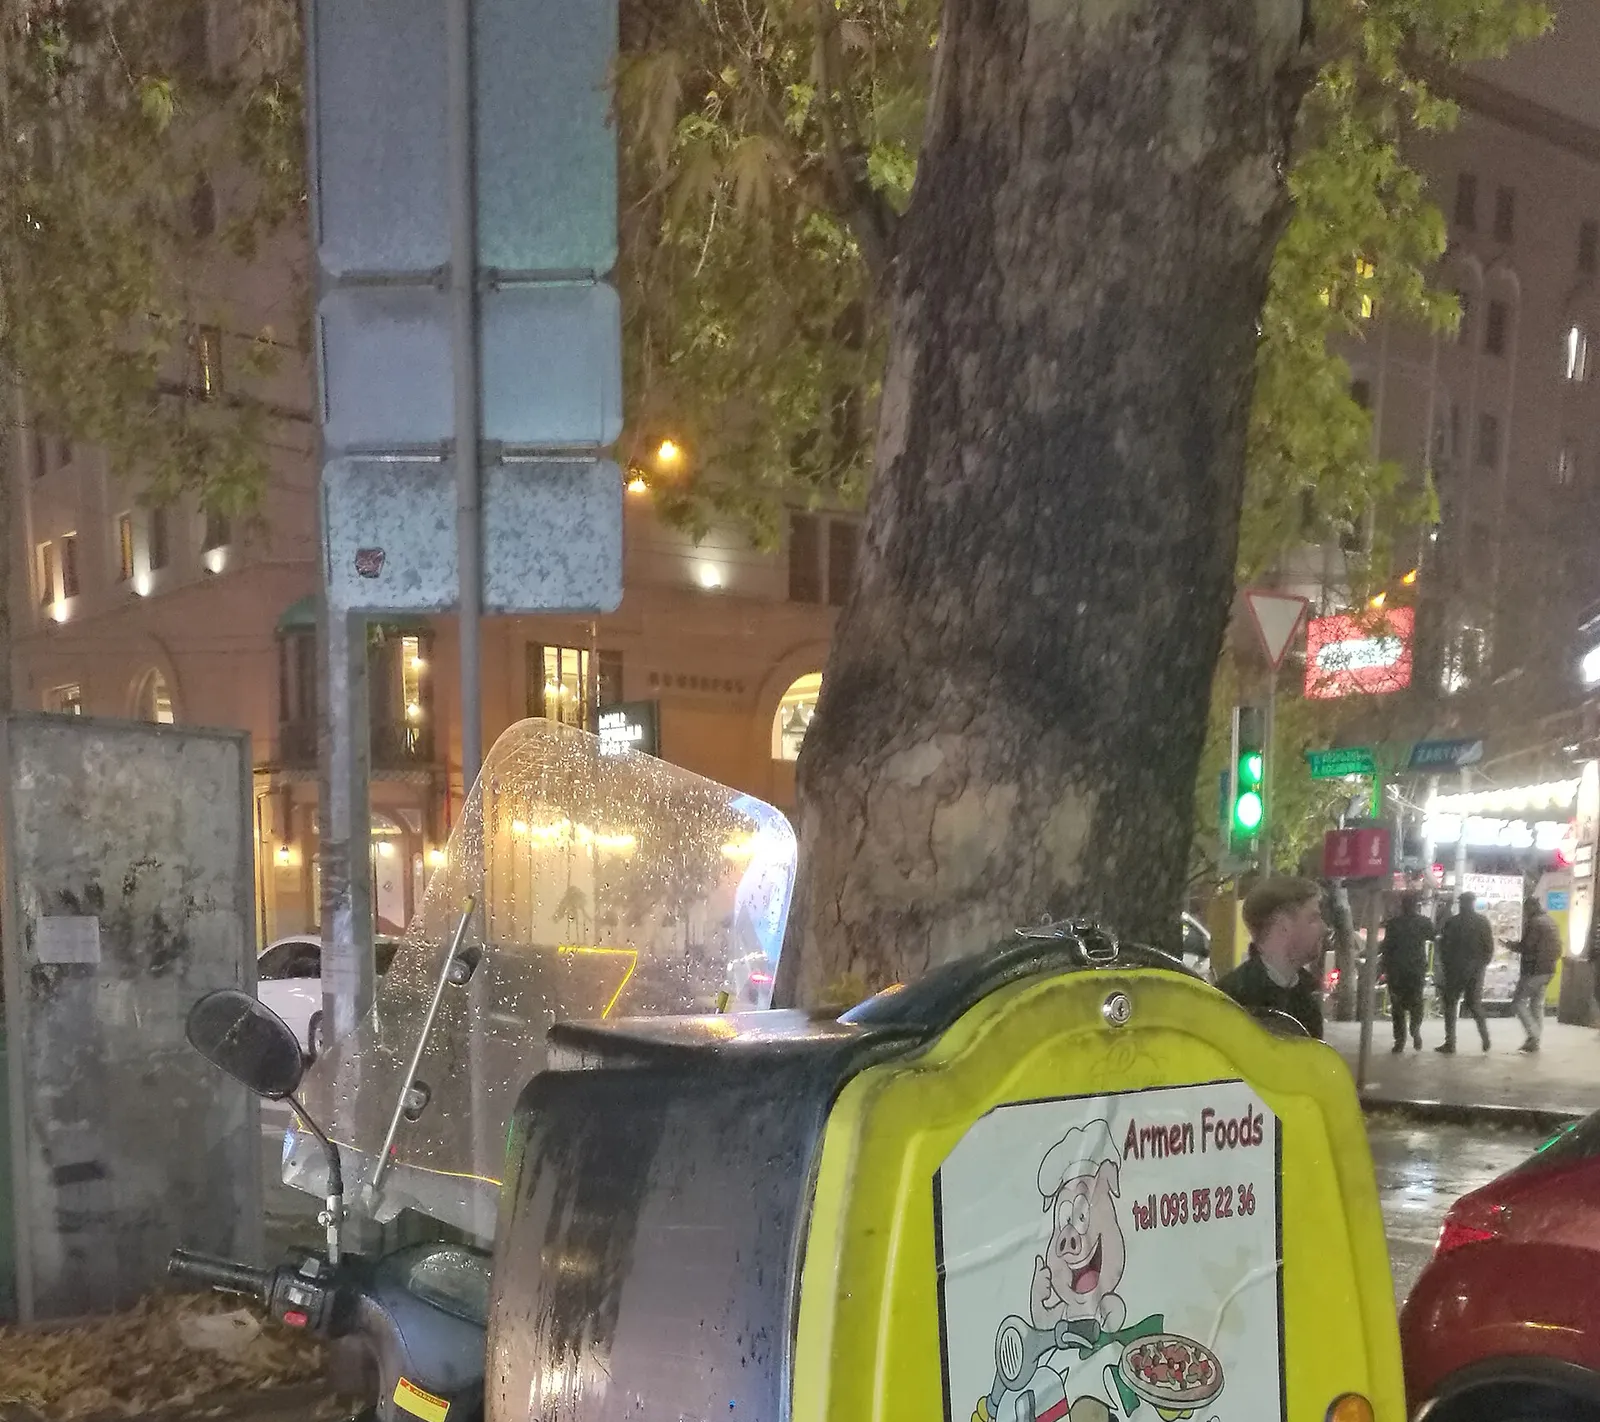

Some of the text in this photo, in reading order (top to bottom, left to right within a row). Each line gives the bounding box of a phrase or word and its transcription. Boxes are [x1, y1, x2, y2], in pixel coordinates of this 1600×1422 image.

[1123, 1103, 1264, 1160] Armen Foods
[1132, 1182, 1256, 1231] tell 093 55 22 36
